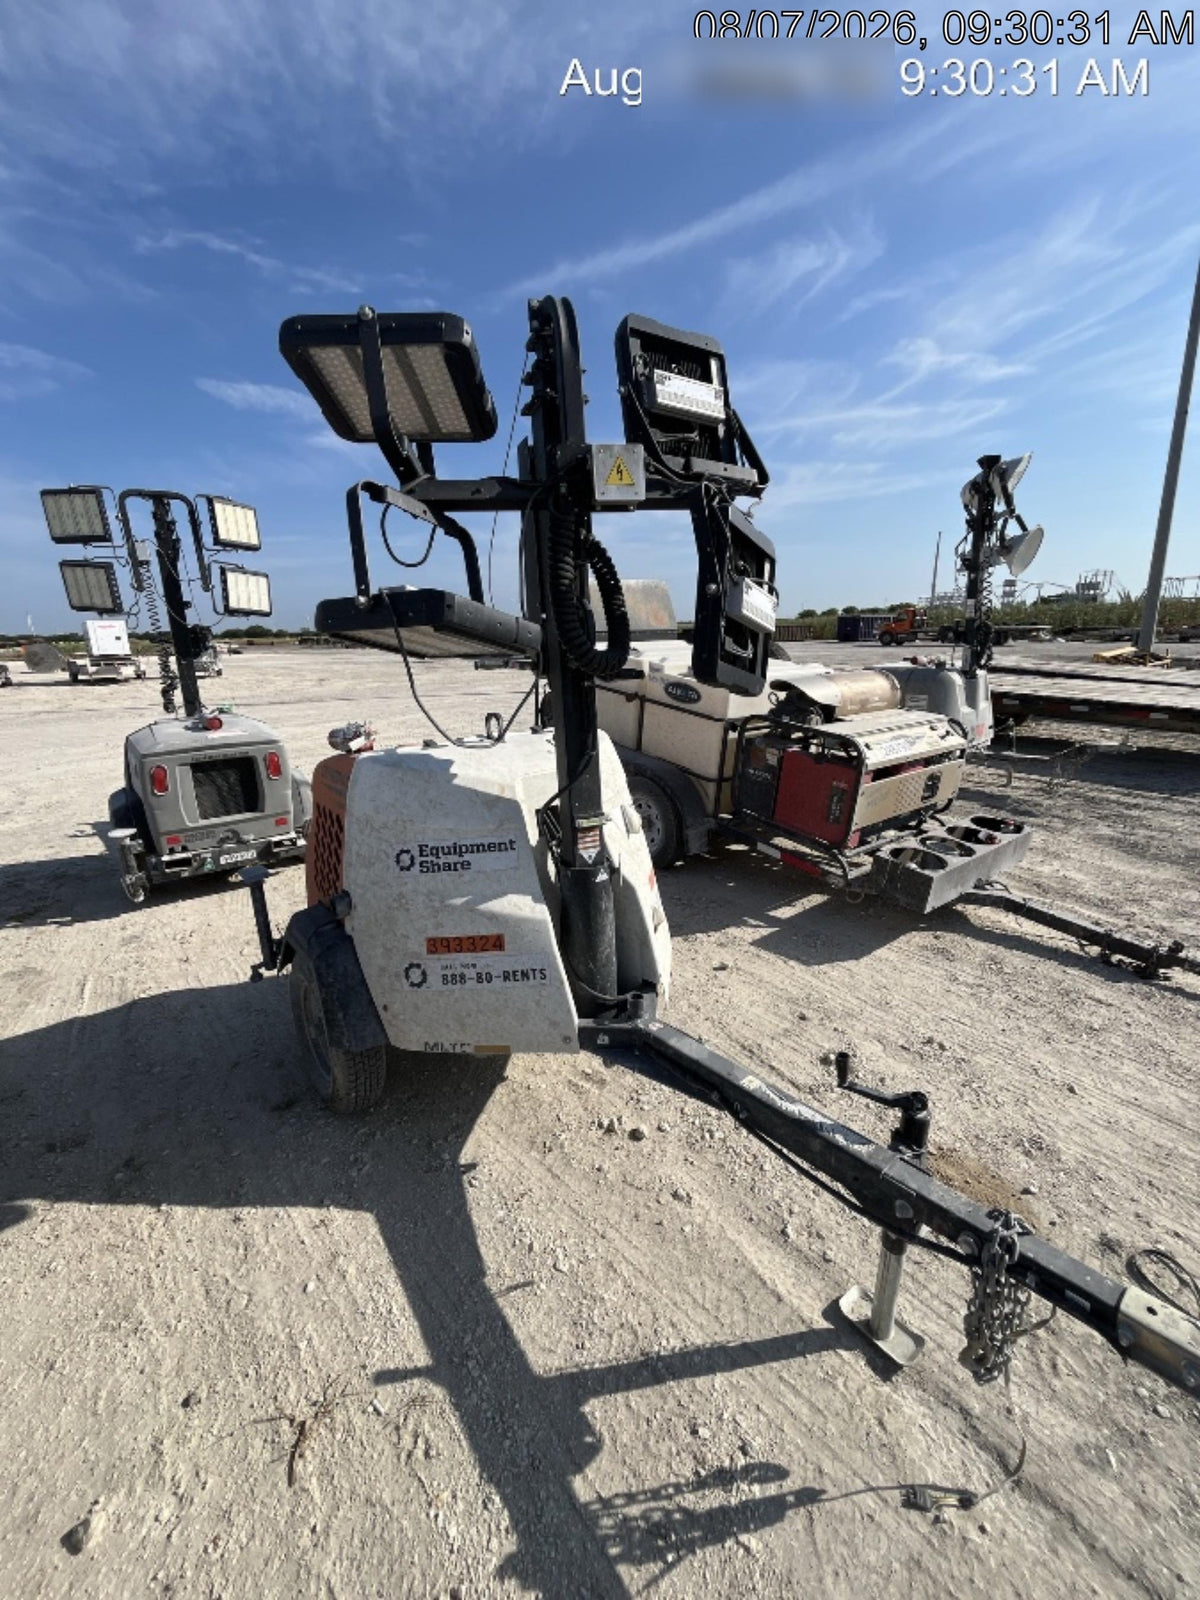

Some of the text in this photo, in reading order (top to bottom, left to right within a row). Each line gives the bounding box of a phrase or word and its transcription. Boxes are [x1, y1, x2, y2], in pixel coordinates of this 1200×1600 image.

[418, 839, 516, 859] Equipment
[419, 860, 472, 873] Share
[427, 935, 504, 953] 393324
[441, 968, 547, 985] 888-80-RENTS
